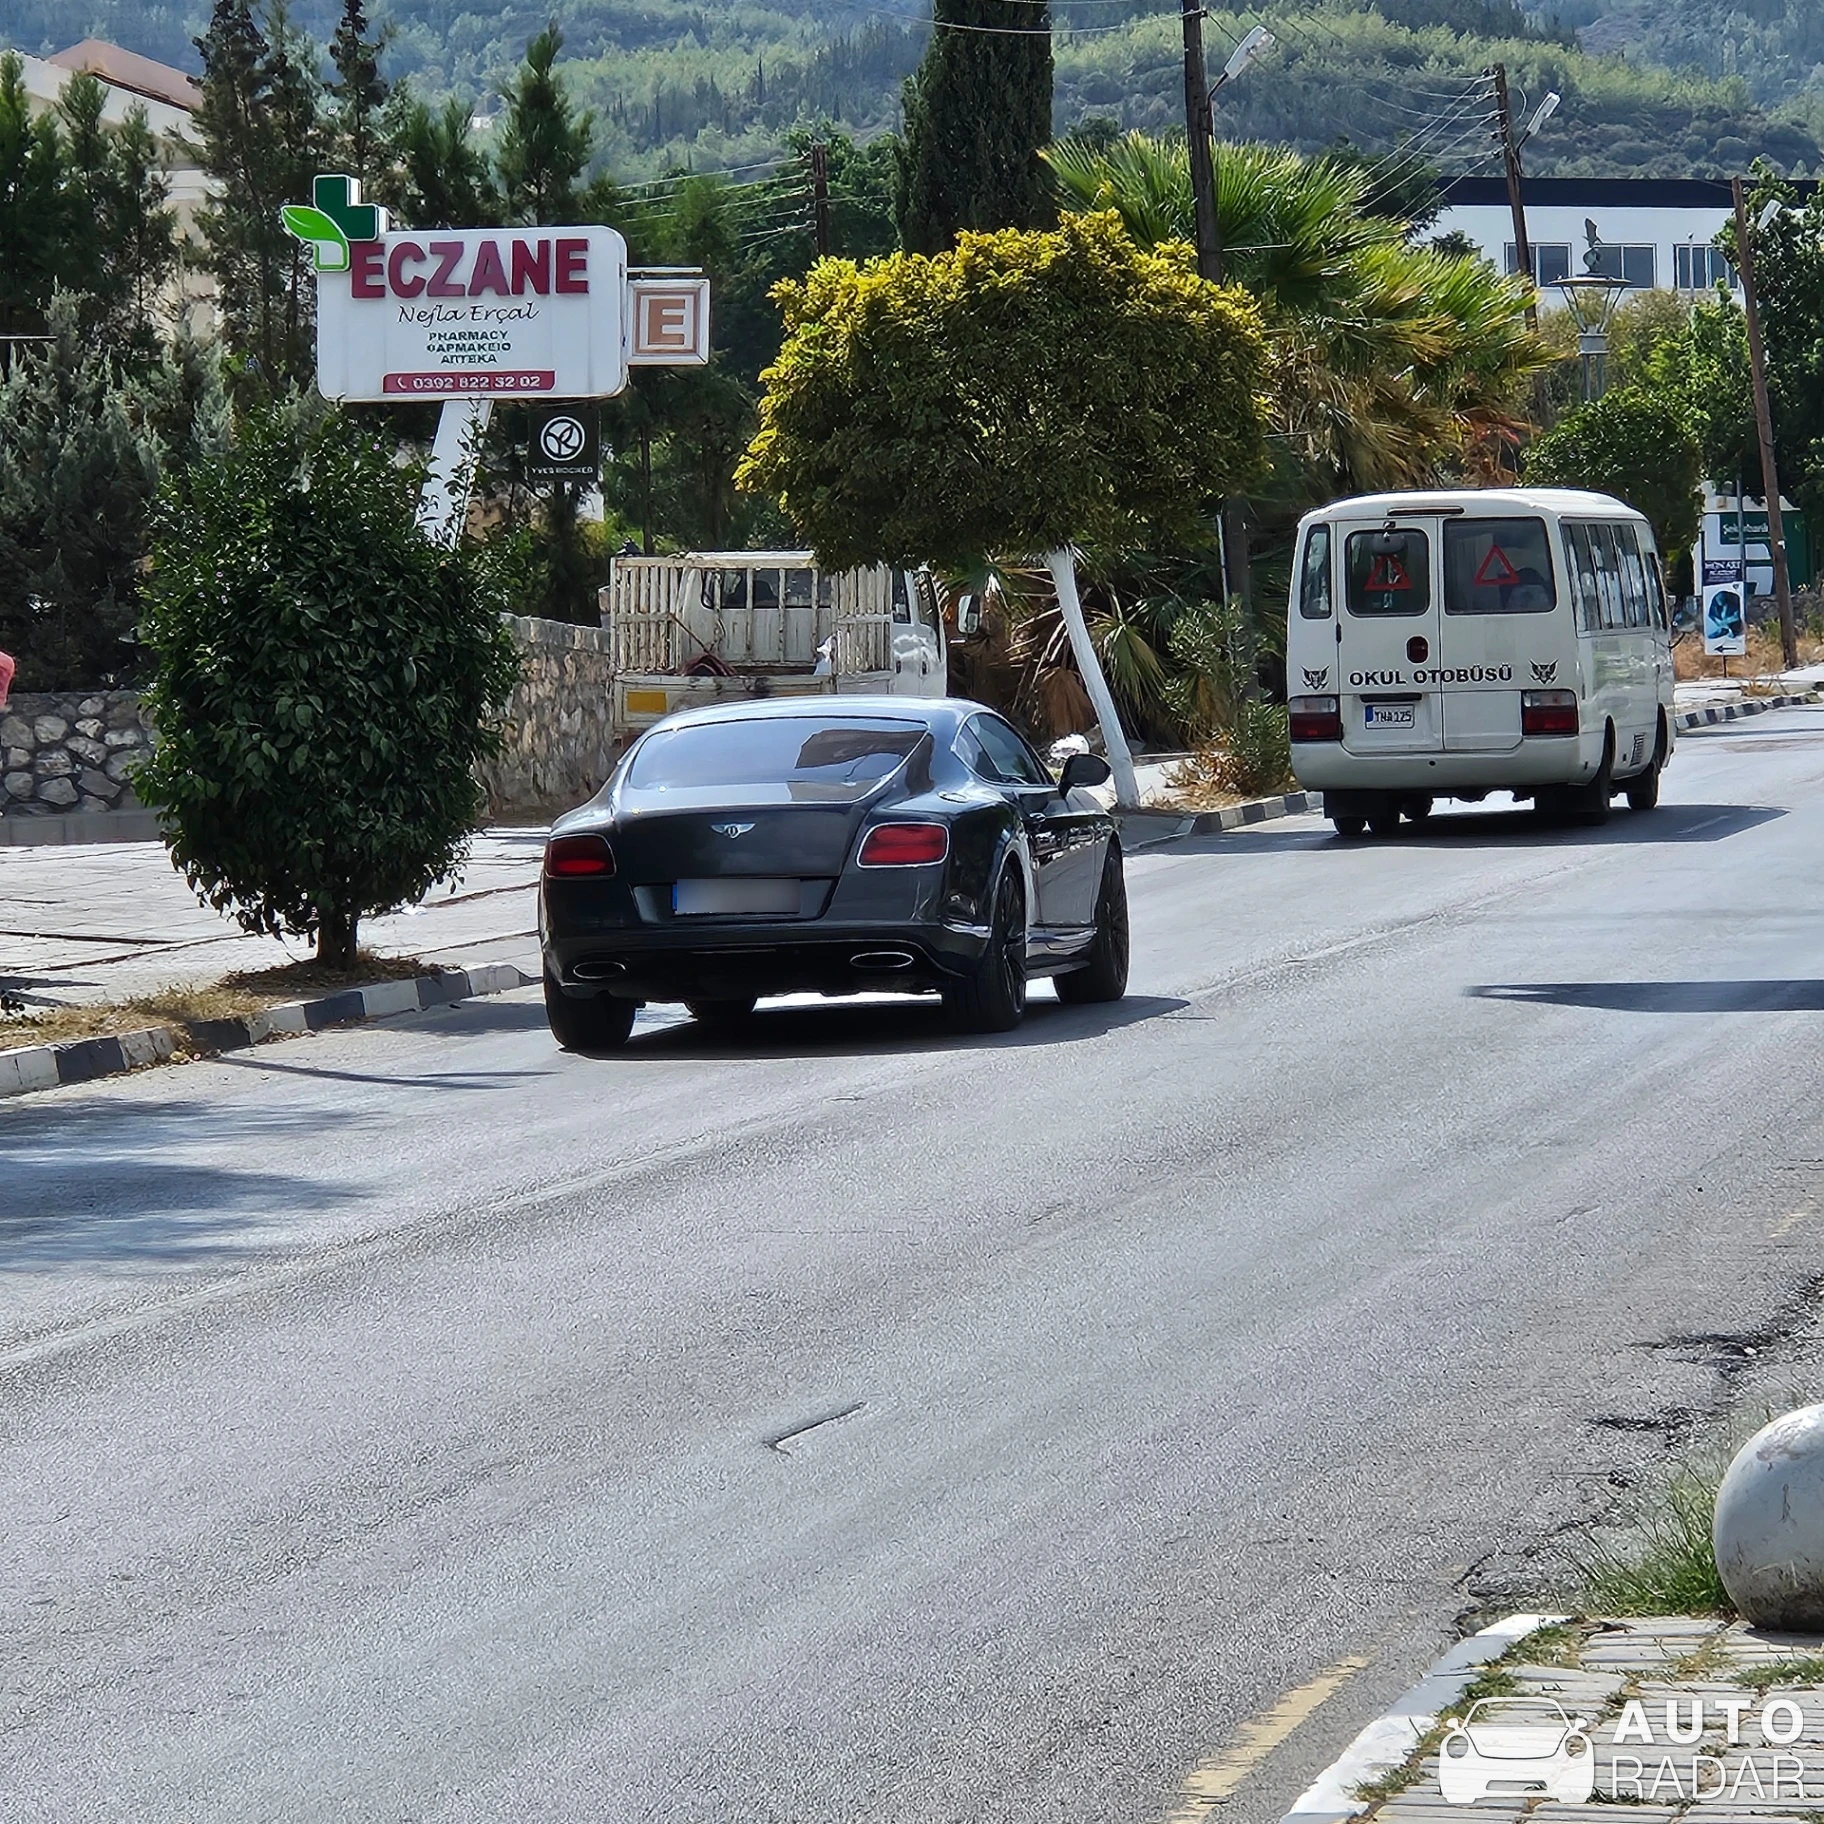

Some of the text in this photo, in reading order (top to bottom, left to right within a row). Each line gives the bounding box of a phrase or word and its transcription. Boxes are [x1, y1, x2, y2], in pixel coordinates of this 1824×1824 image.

[350, 238, 590, 299] ECZANE
[398, 301, 540, 328] Nejla Erçal
[646, 299, 686, 346] E
[428, 330, 509, 342] PHARMACY
[459, 376, 490, 388] 822
[519, 375, 541, 387] 02
[1349, 663, 1513, 686] OKUL OTOBÜSÜ
